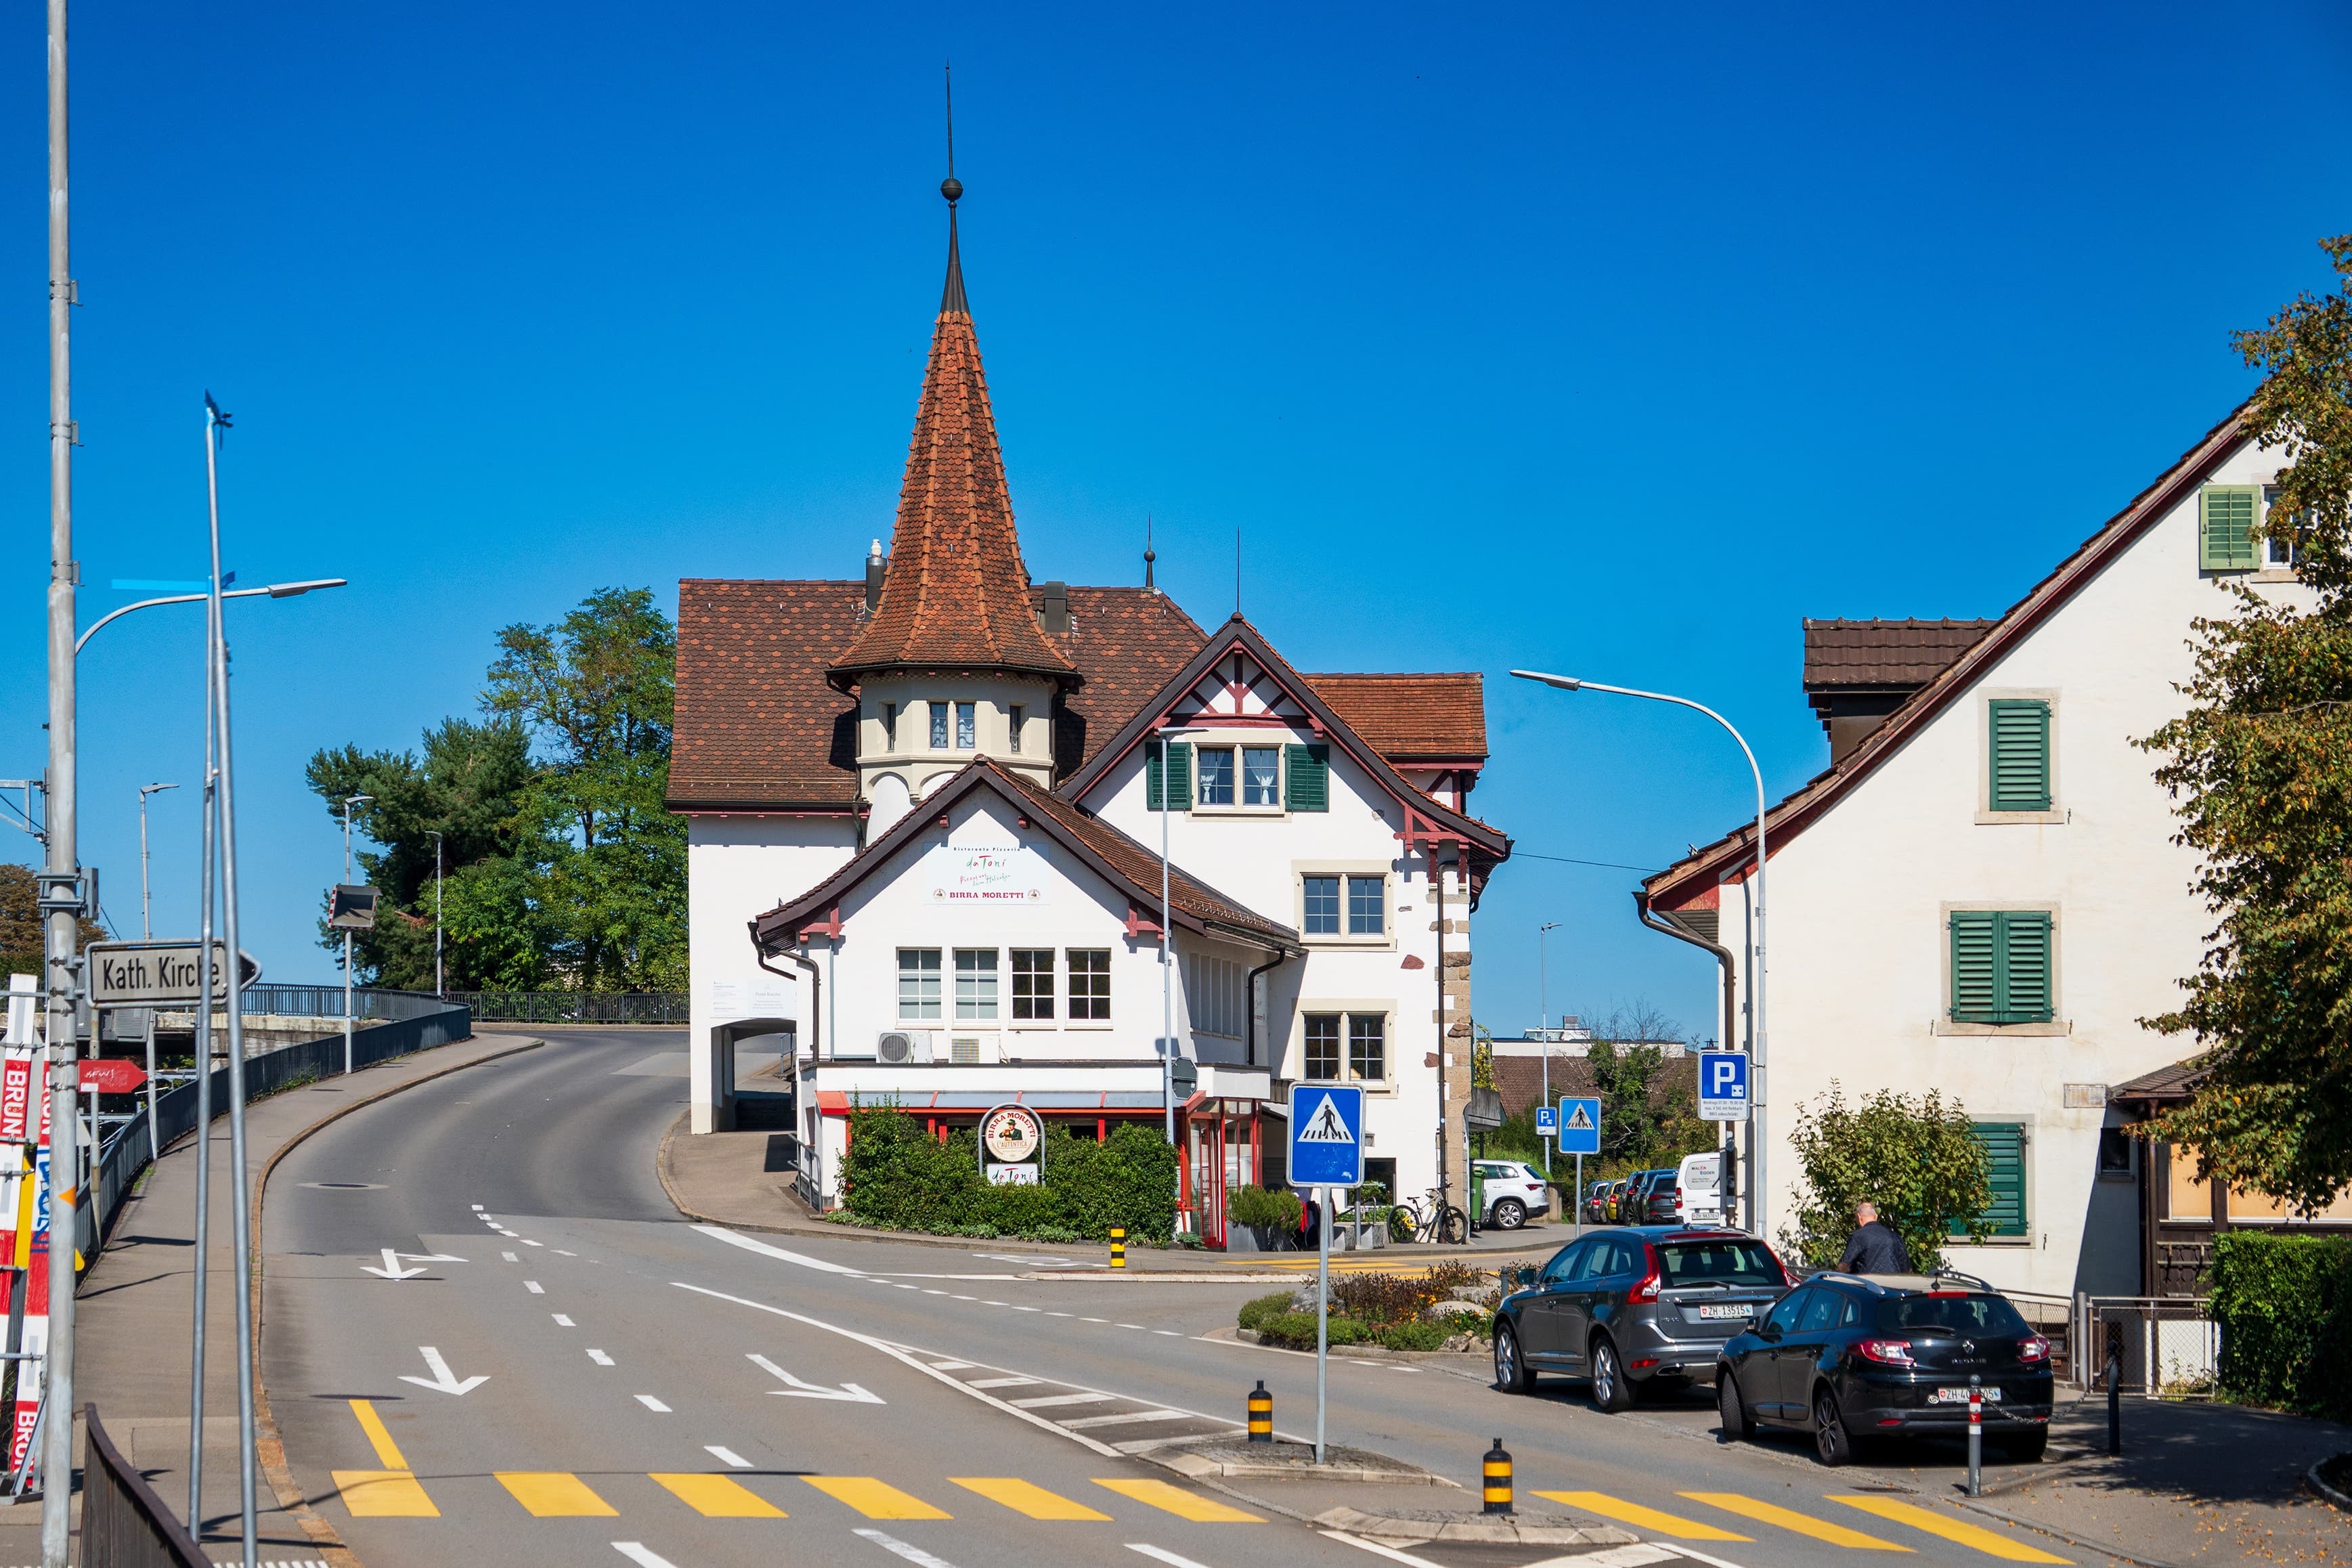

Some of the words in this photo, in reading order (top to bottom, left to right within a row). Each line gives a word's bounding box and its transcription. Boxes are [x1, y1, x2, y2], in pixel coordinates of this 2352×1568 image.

[979, 855, 1007, 869] Toni
[104, 958, 152, 990] Kath.
[1714, 1061, 1735, 1094] P
[2, 1070, 26, 1134] BRUN
[988, 1114, 1006, 1139] BIRRA
[1007, 1112, 1036, 1137] MORETTI
[1540, 1110, 1549, 1123] P
[997, 1140, 1028, 1148] L'AUTENTICA
[992, 1169, 1005, 1181] da
[1005, 1167, 1034, 1181] Toni
